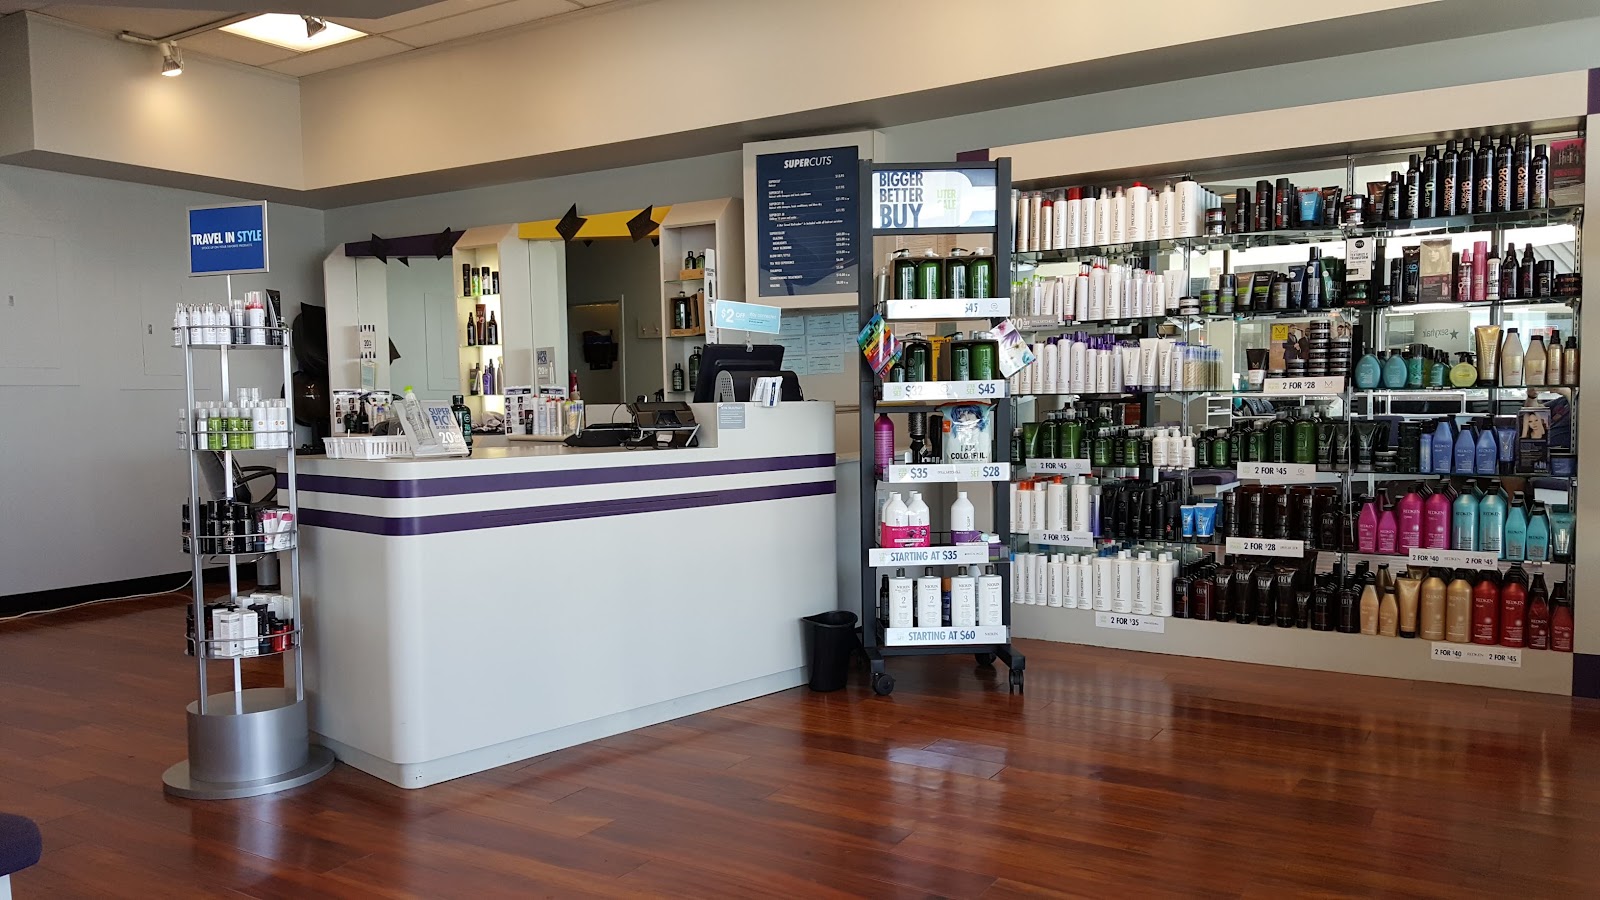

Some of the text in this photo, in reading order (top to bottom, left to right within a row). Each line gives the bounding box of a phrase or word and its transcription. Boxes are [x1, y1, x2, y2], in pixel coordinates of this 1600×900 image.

[784, 156, 832, 169] SUPERCUTS
[880, 172, 923, 187] BIGGER
[1499, 167, 1508, 180] 28
[1518, 167, 1527, 180] 32
[1536, 168, 1546, 180] 05
[1425, 182, 1434, 191] 10
[1445, 178, 1454, 187] 12
[1462, 181, 1471, 189] 18
[1483, 178, 1492, 190] 23
[880, 188, 956, 202] BETTER LITER
[880, 203, 923, 228] BUY
[192, 230, 261, 246] TRAVEL IN STYLE
[1409, 263, 1418, 273] 16
[721, 308, 734, 323] $2
[978, 384, 995, 394] $45
[432, 416, 455, 425] PICK
[910, 468, 927, 479] $35
[983, 466, 1000, 477] $28
[890, 552, 928, 561] STARTING
[931, 551, 940, 560] AT
[942, 550, 957, 560] $35
[909, 631, 945, 641] STARTING
[949, 631, 957, 640] AT
[960, 630, 976, 640] $60
